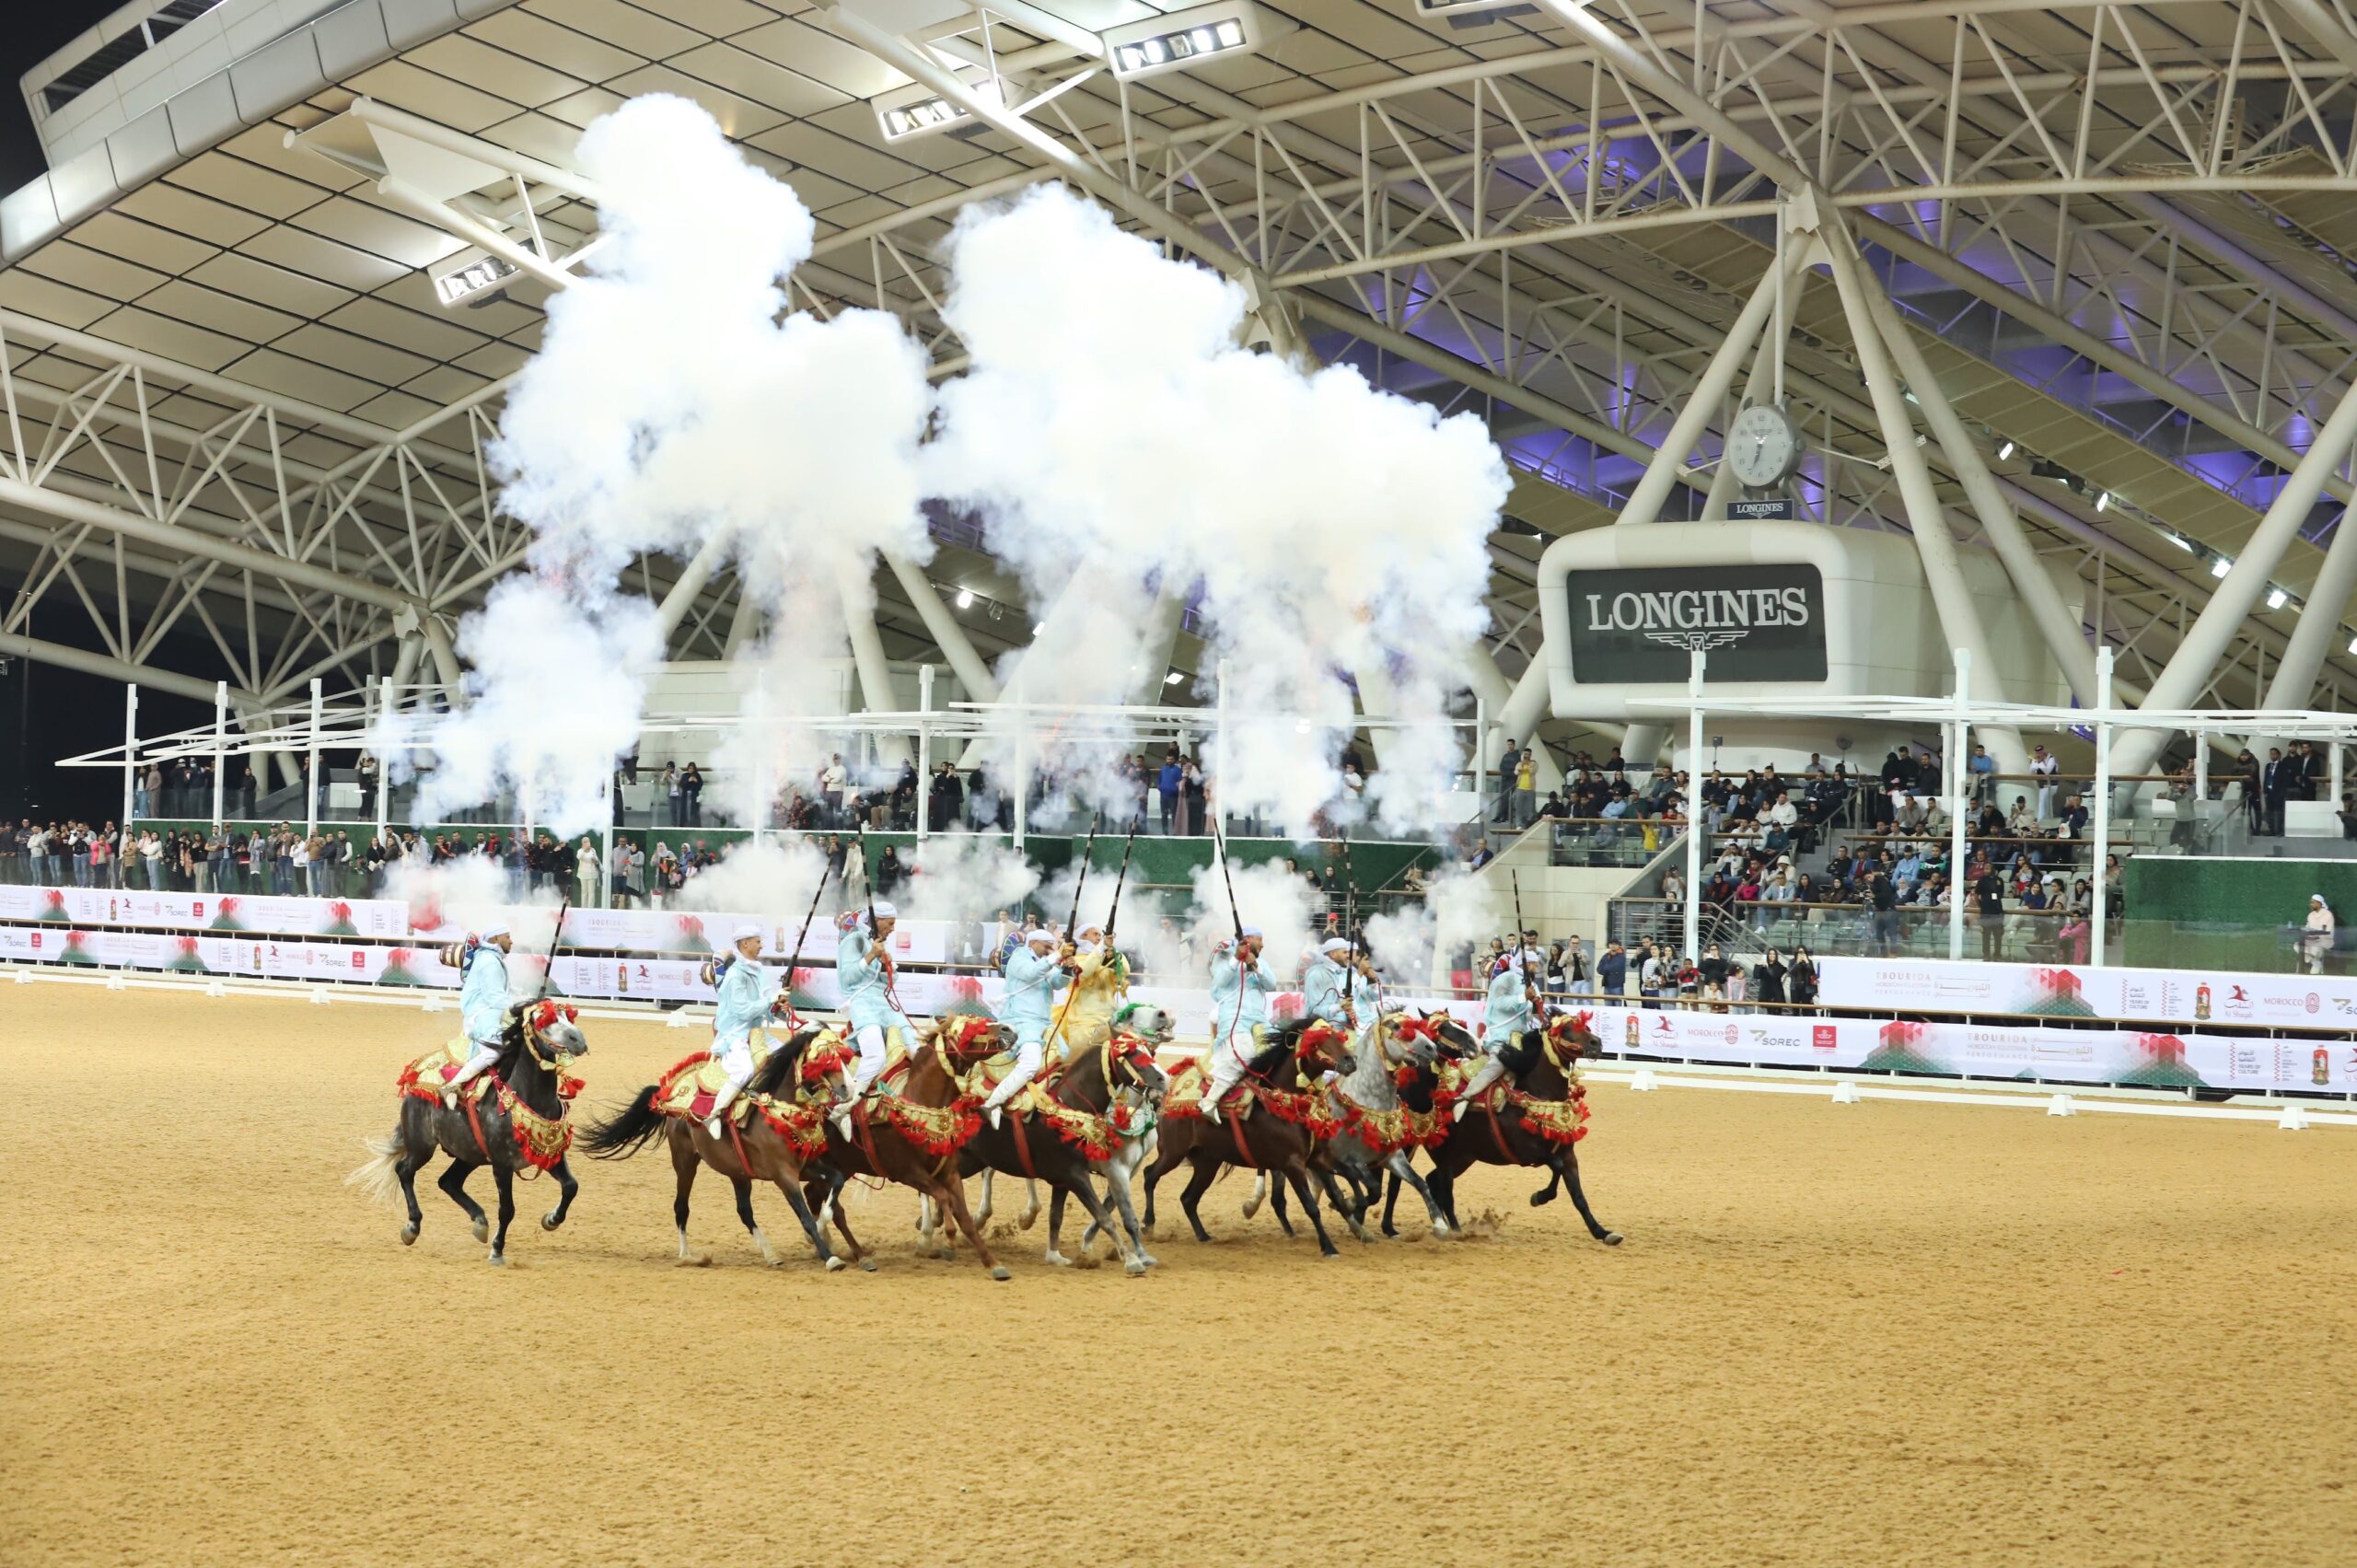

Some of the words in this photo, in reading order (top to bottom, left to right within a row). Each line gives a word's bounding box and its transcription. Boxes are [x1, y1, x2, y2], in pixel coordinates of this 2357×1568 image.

[1736, 503, 1784, 514] LONGINES
[1586, 587, 1809, 631] LONGINES
[1876, 971, 1932, 981] TBOURIDA
[2263, 997, 2304, 1006] MOROCCO
[1688, 1028, 1724, 1038] MOROCCO
[1967, 1033, 2027, 1043] TBOURIDA
[1762, 1038, 1801, 1047] SOREC
